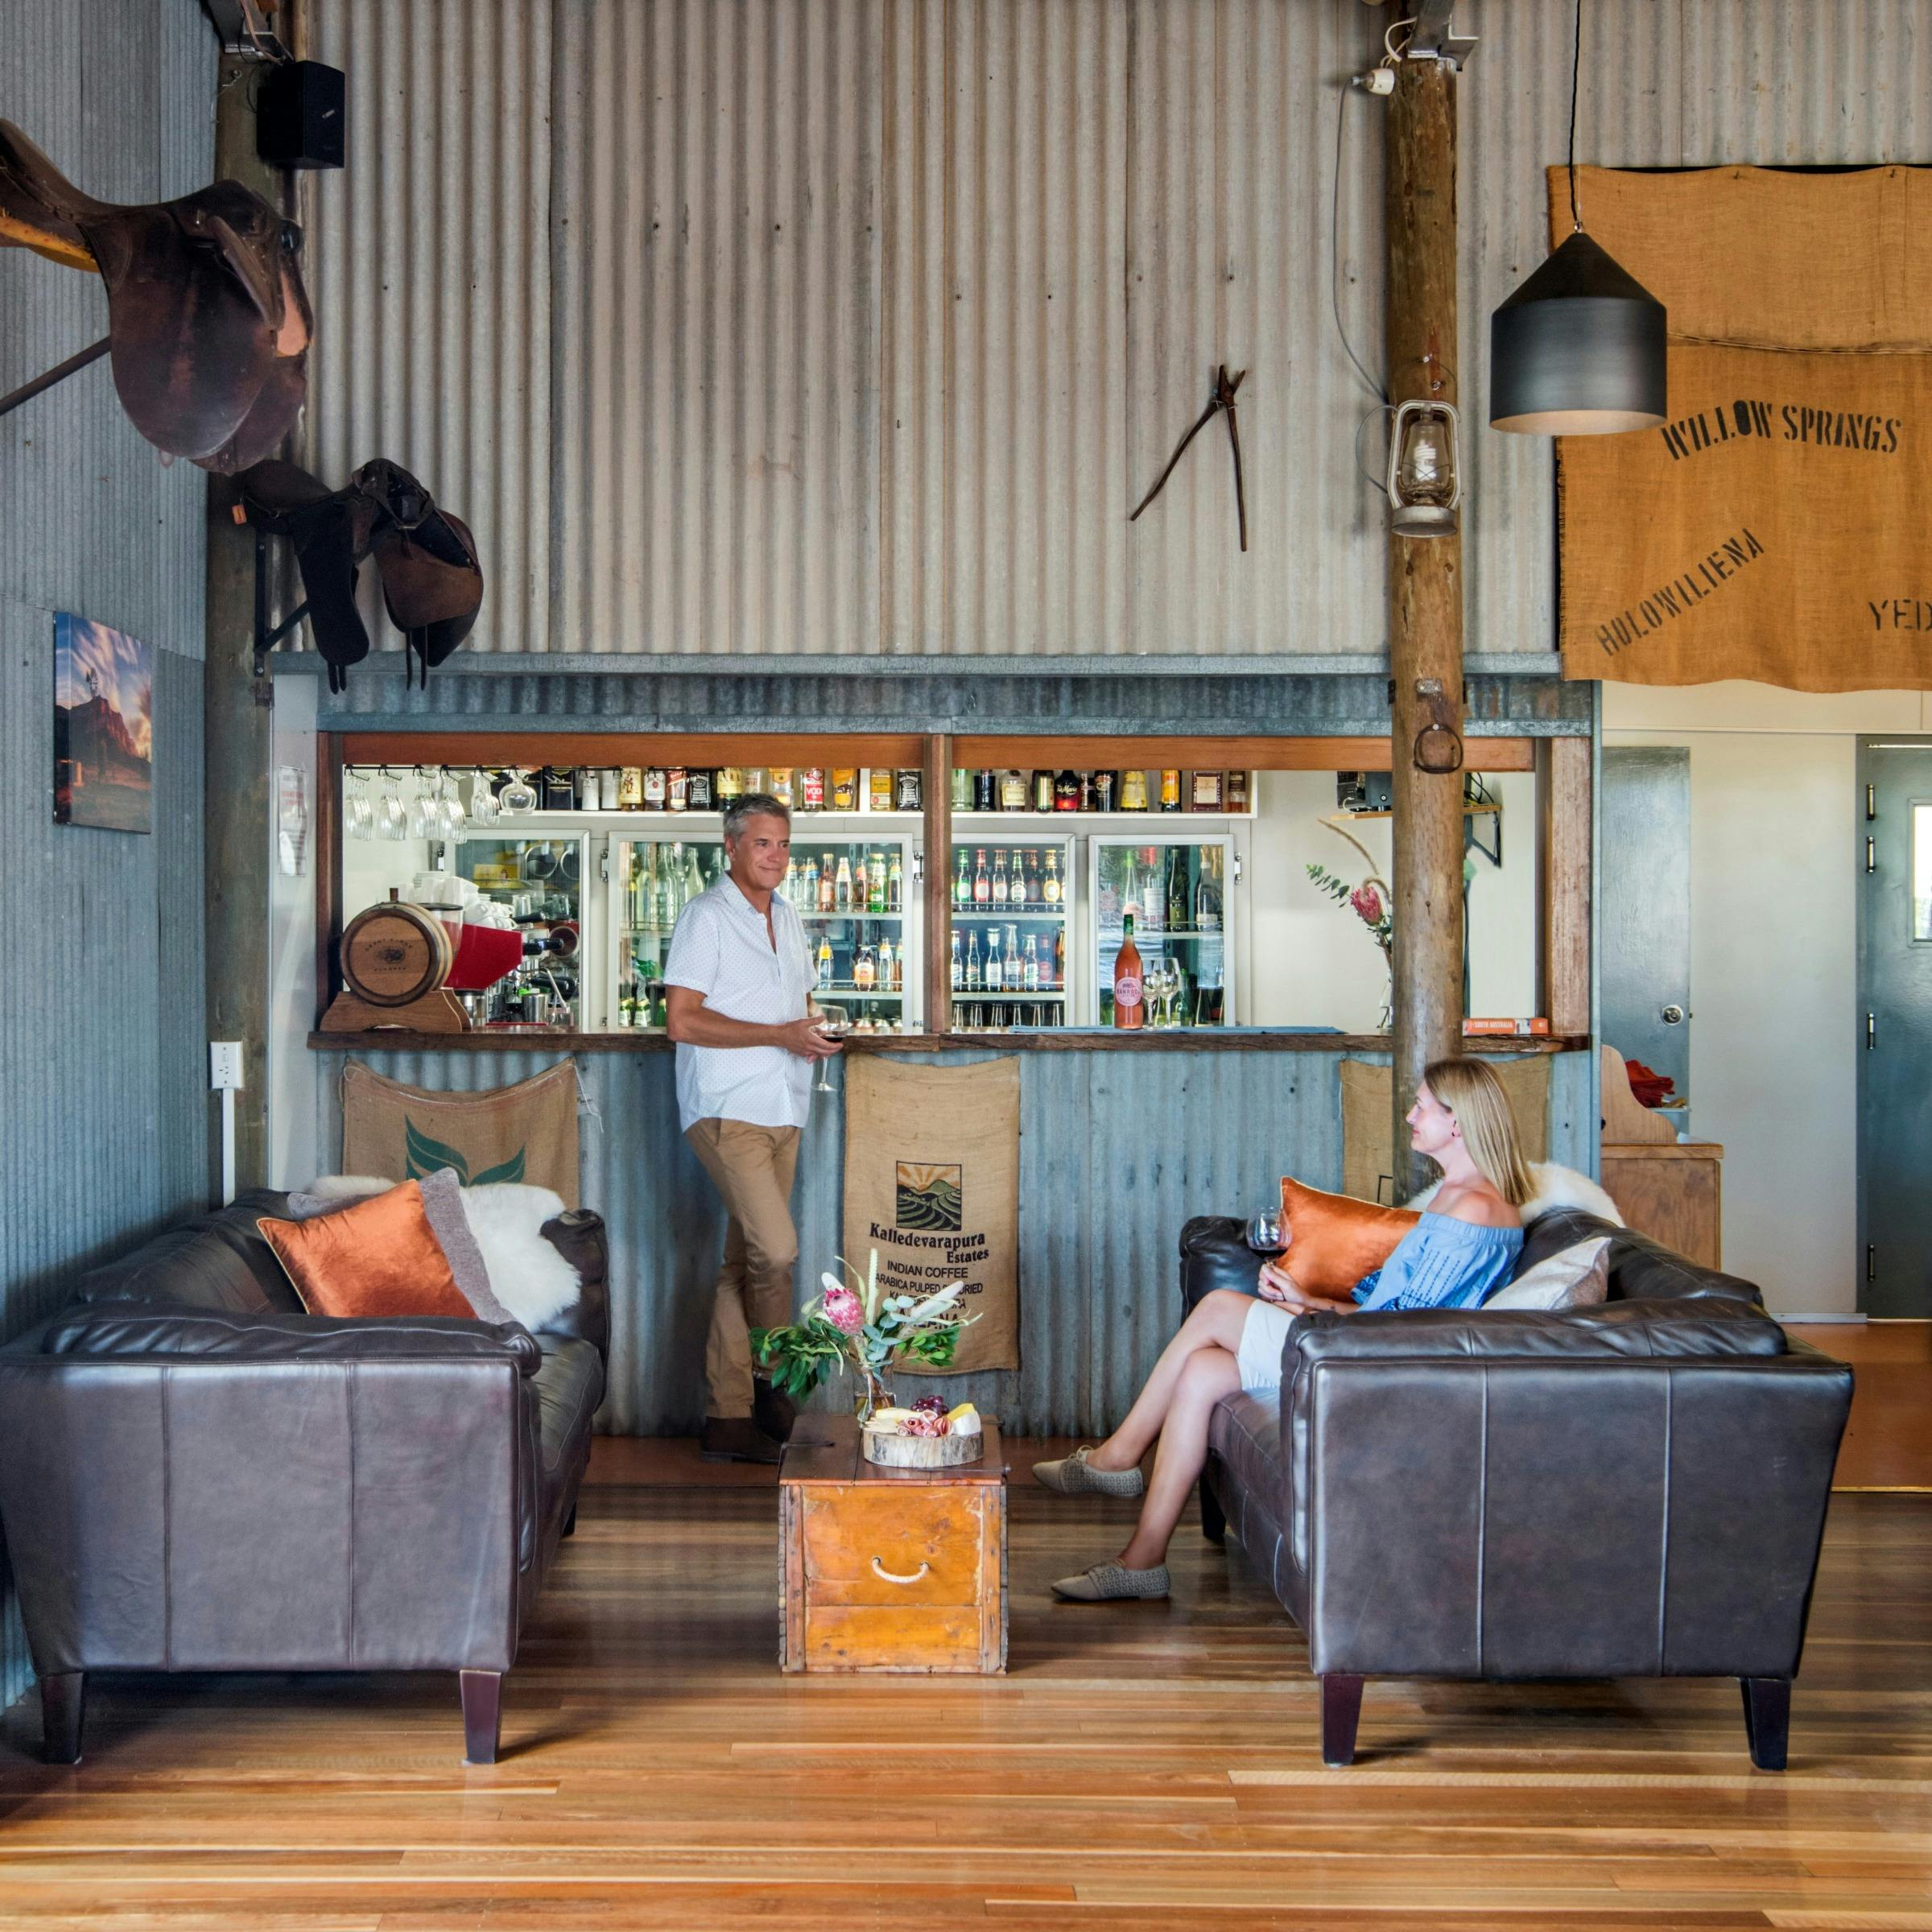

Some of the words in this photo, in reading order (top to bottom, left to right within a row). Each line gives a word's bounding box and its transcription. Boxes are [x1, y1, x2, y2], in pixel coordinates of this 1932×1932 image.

[1660, 399, 1773, 460] WILLOW
[1781, 404, 1903, 454] SPRINGS
[1595, 527, 1765, 657] HOLOWILIENA
[869, 1222, 985, 1252] Kalledevarapura
[887, 1260, 923, 1278] INDIAN
[925, 1266, 968, 1278] COFFEE
[947, 1249, 989, 1264] Estates
[876, 1273, 909, 1290] ARABICA
[910, 1281, 940, 1294] PULPED
